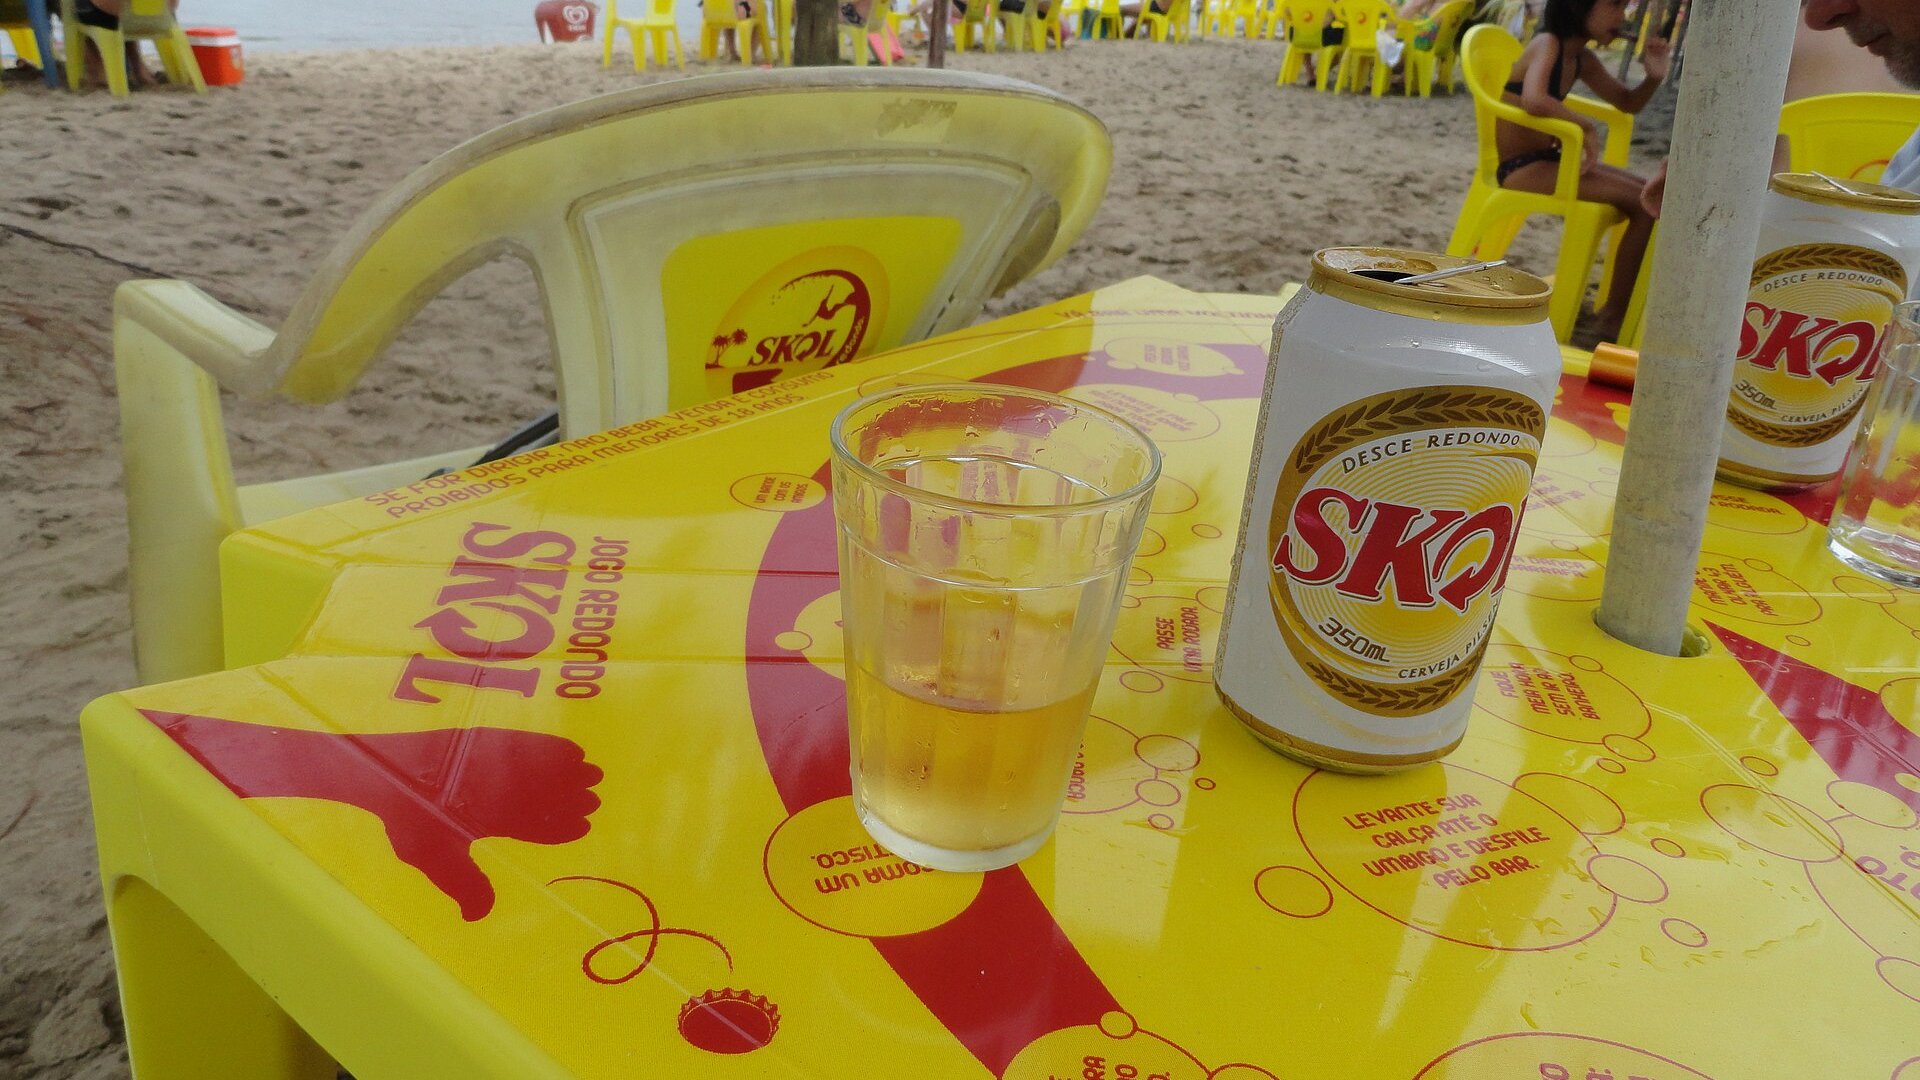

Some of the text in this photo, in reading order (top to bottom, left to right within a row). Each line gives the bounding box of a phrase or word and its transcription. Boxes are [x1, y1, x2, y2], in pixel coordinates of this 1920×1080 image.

[1764, 271, 1883, 293] DESCE REDONDO
[747, 329, 836, 366] SKOL
[1781, 412, 1827, 423] CERVEJA
[365, 489, 408, 506] SE
[407, 473, 466, 495] FOR
[667, 399, 734, 421] VENDA
[746, 371, 835, 400] CONSUMO
[1341, 431, 1521, 474] DESCE REDONDO
[386, 473, 528, 519] PROIBIDOS
[527, 454, 595, 478] PARA
[592, 424, 700, 459] MENORES
[696, 414, 731, 429] DE
[727, 407, 755, 419] 18
[1272, 487, 1529, 614] SKO
[391, 521, 577, 705] SKOL
[555, 535, 630, 700] JOGO REDONDO
[1156, 616, 1175, 651] PASSE
[1398, 653, 1460, 679] CERVEJA
[1343, 793, 1482, 831] LEVANTE SUA
[1371, 811, 1499, 849] CALÇA ATÉ O
[810, 842, 895, 870] TISCO.
[1361, 825, 1551, 878] UMBIGO E DESFILE
[814, 872, 861, 894] UM
[1432, 854, 1541, 890] PELO BAR.
